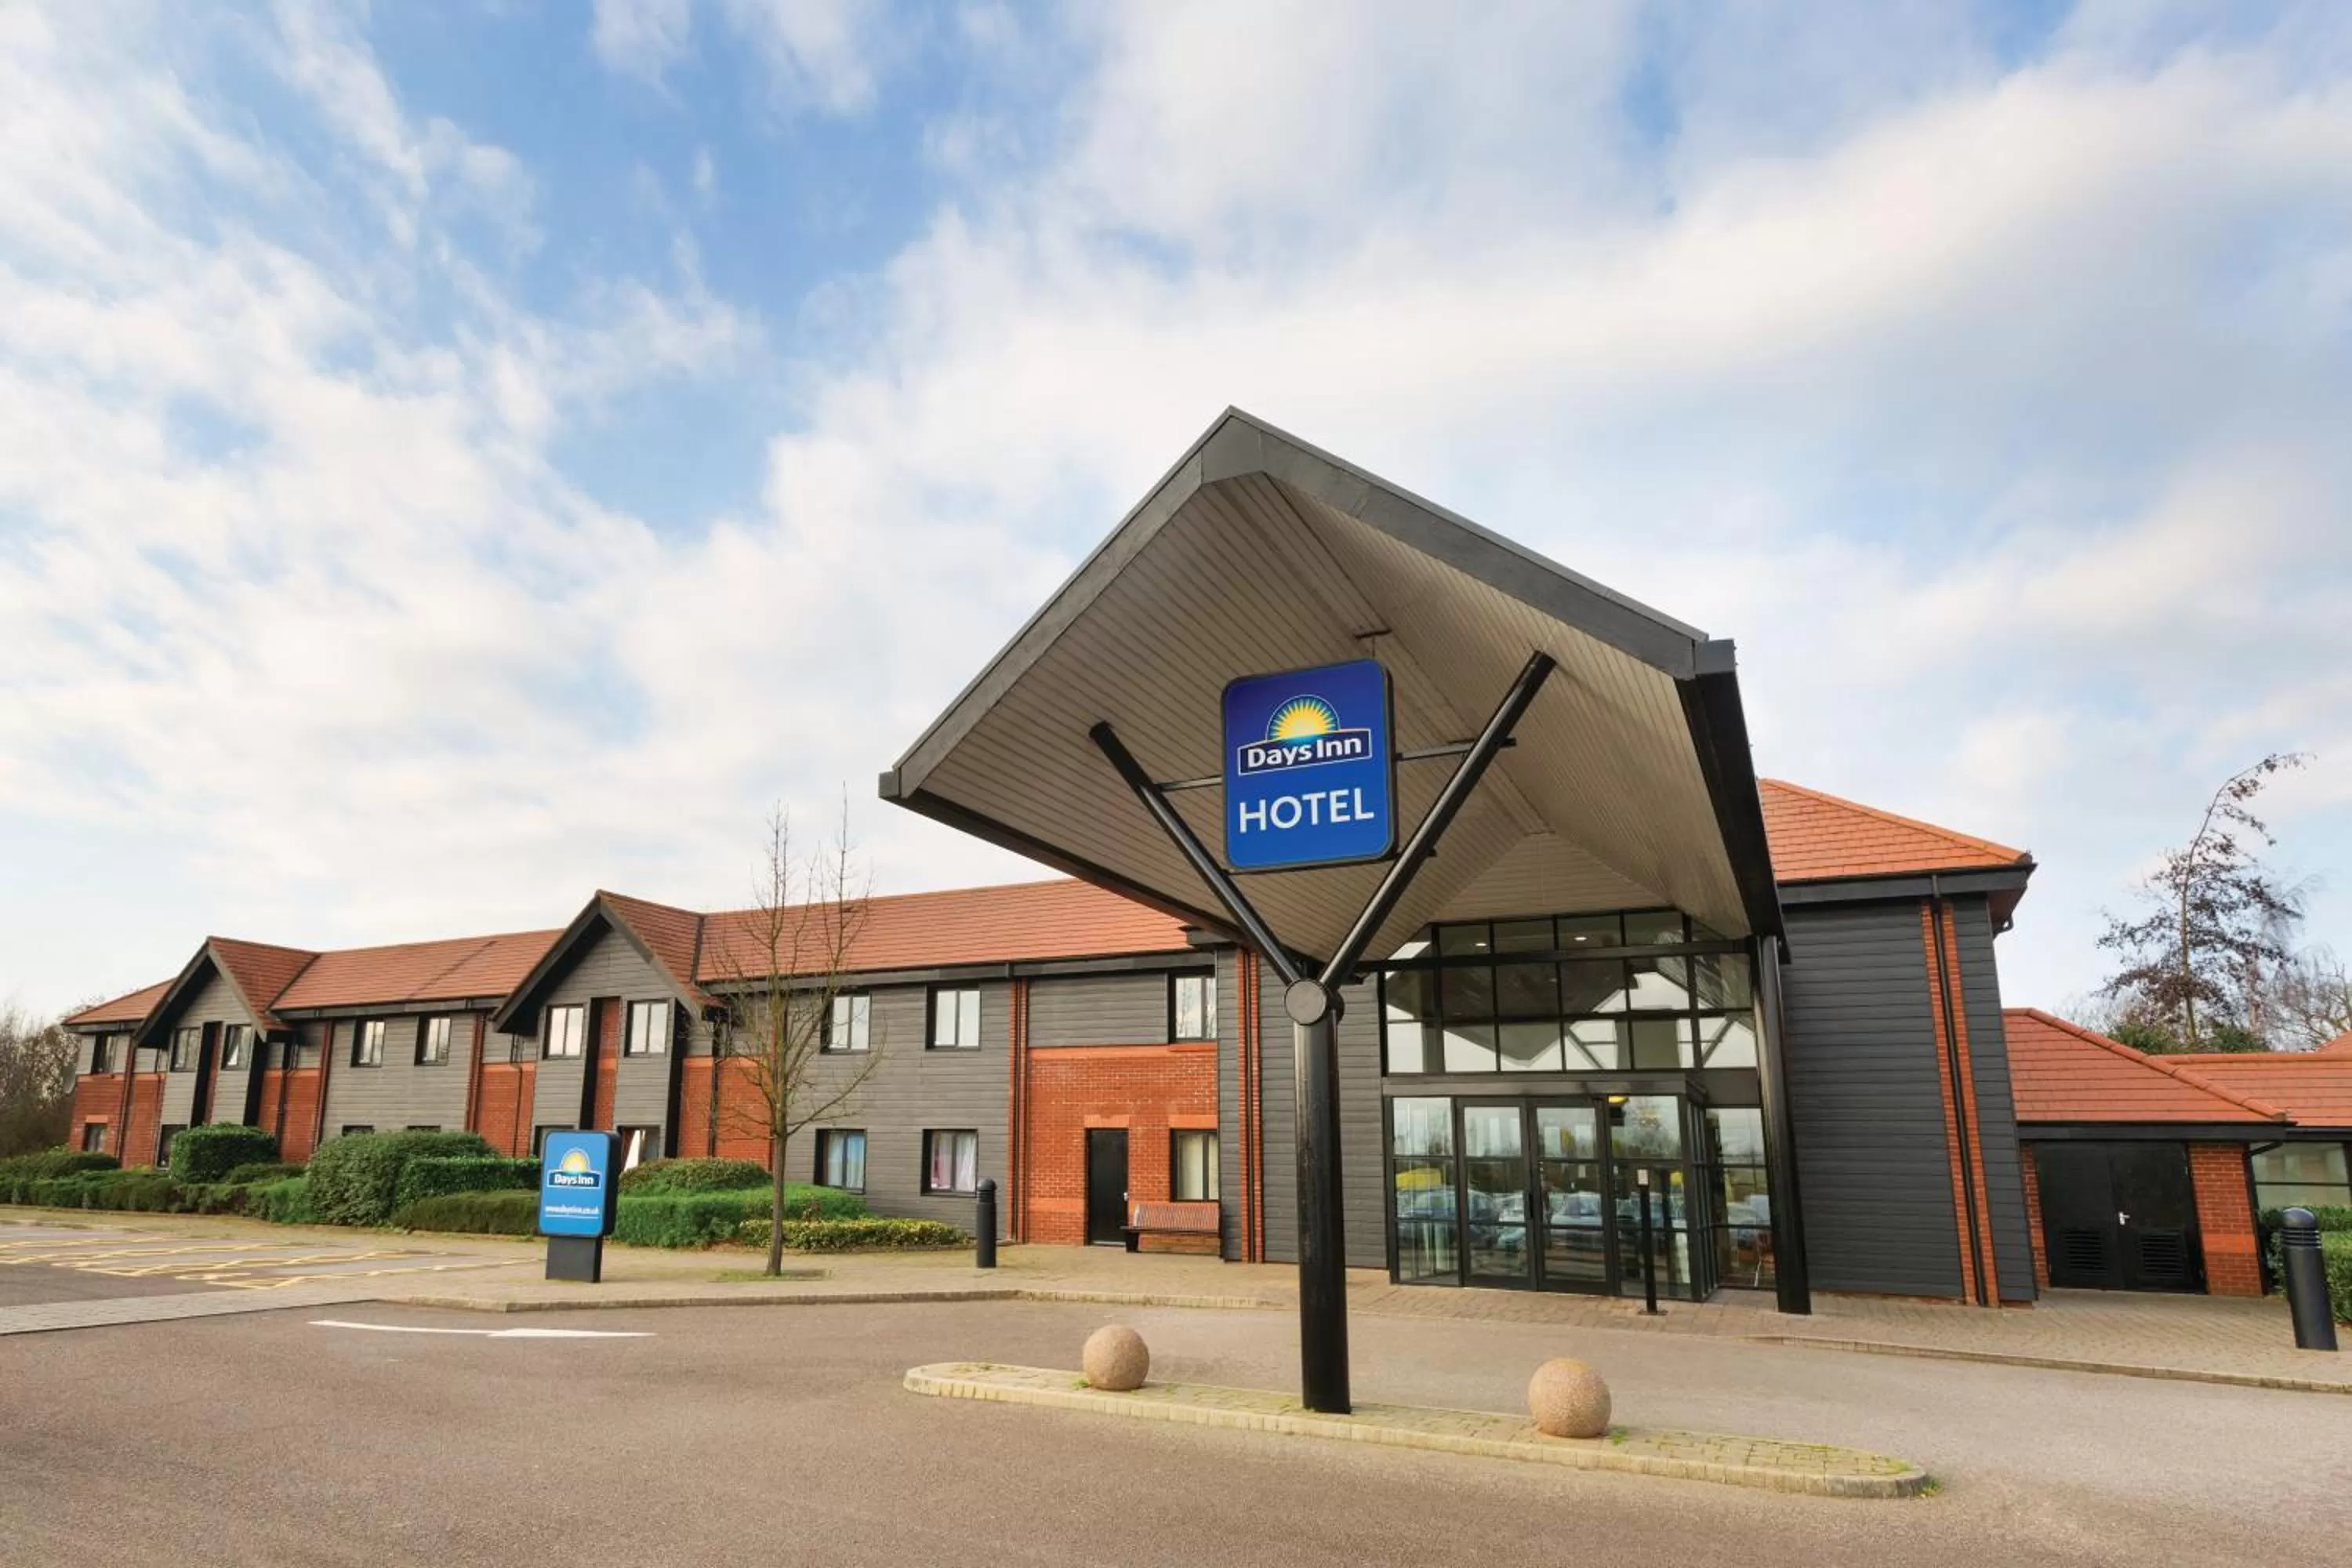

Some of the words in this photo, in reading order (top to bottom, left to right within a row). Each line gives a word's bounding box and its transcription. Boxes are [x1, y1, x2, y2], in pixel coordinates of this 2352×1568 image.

[1247, 744, 1312, 768] Days
[1316, 737, 1362, 759] Inn
[1240, 787, 1374, 833] HOTEL
[554, 1174, 578, 1185] Days
[578, 1174, 594, 1185] Inn
